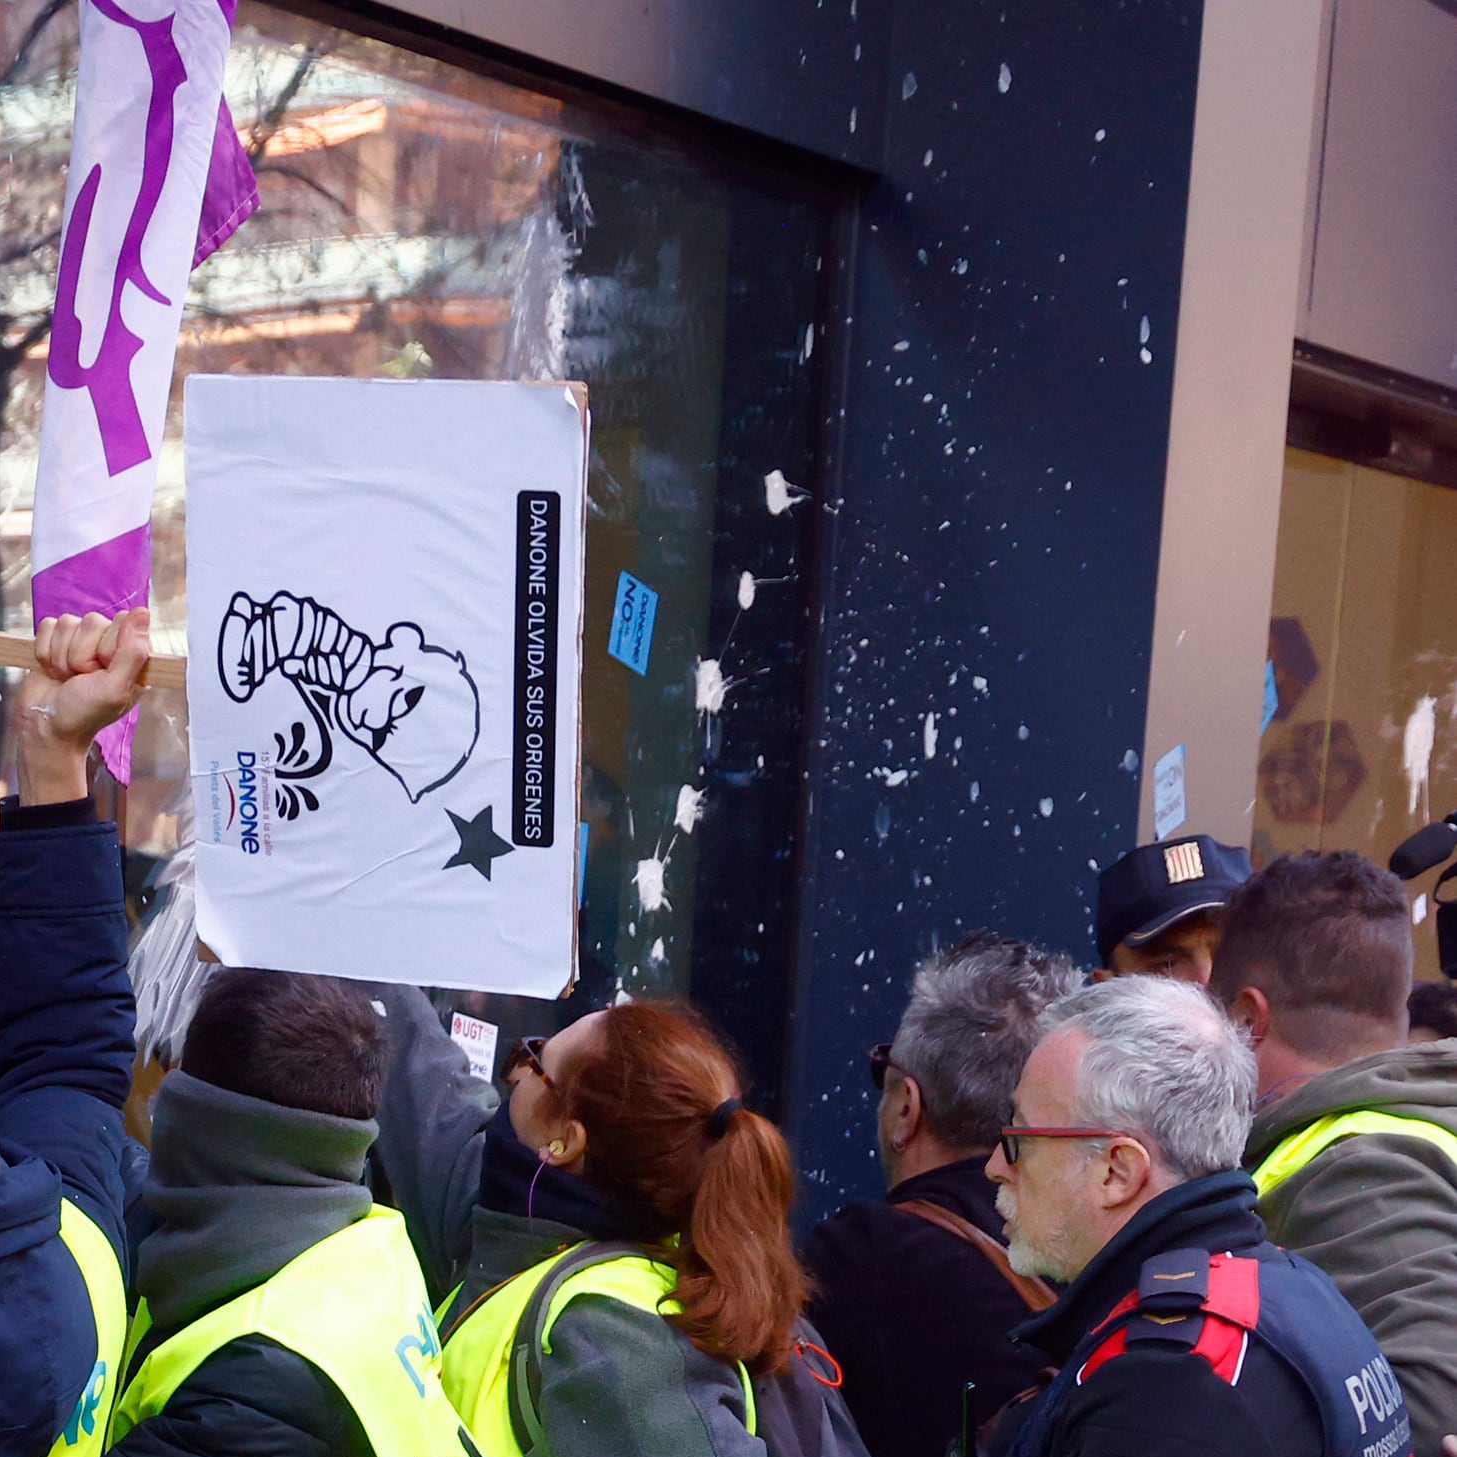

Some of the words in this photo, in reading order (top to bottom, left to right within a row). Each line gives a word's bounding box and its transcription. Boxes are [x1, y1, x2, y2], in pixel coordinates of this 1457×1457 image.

[529, 499, 548, 596] DANONE
[622, 579, 637, 622] NO
[526, 601, 547, 681] OLVIDA
[526, 685, 545, 729] SUS
[524, 733, 543, 841] ORIGENES
[463, 1019, 484, 1042] UGT
